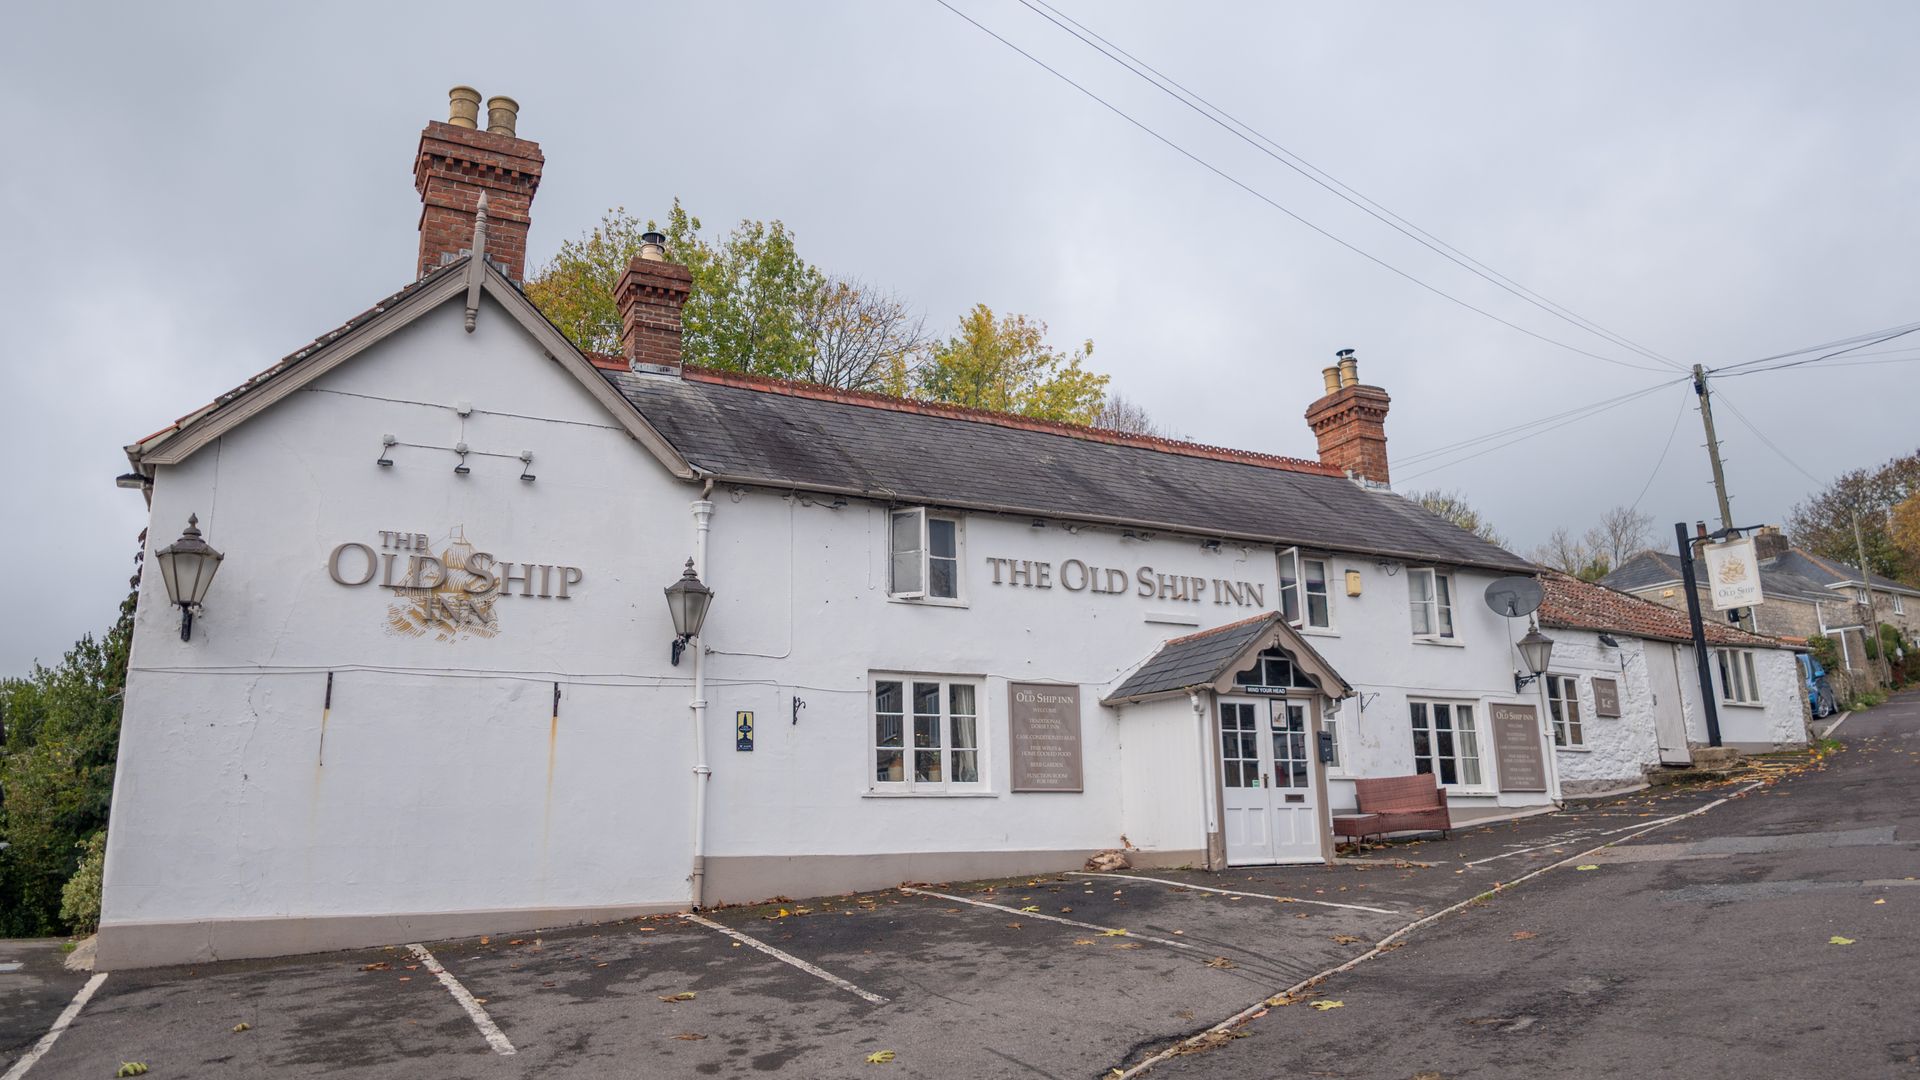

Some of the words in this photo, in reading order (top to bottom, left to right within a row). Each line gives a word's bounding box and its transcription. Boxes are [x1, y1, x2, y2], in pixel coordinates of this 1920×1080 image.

[378, 530, 429, 551] THE
[328, 542, 448, 590] OLD
[463, 552, 584, 599] SHIP
[986, 557, 1053, 589] THE
[1060, 558, 1129, 594] OLD
[1136, 566, 1207, 602] SHIP
[1212, 578, 1265, 608] INN
[1718, 589, 1736, 598] OLD
[1737, 586, 1755, 594] SHIP
[421, 596, 489, 624] INN
[1016, 692, 1036, 703] OLD
[1036, 693, 1057, 703] SHIP
[1058, 696, 1074, 704] INN
[1495, 711, 1509, 720] OLD
[1509, 711, 1522, 721] SHIP
[1522, 713, 1534, 721] INN
